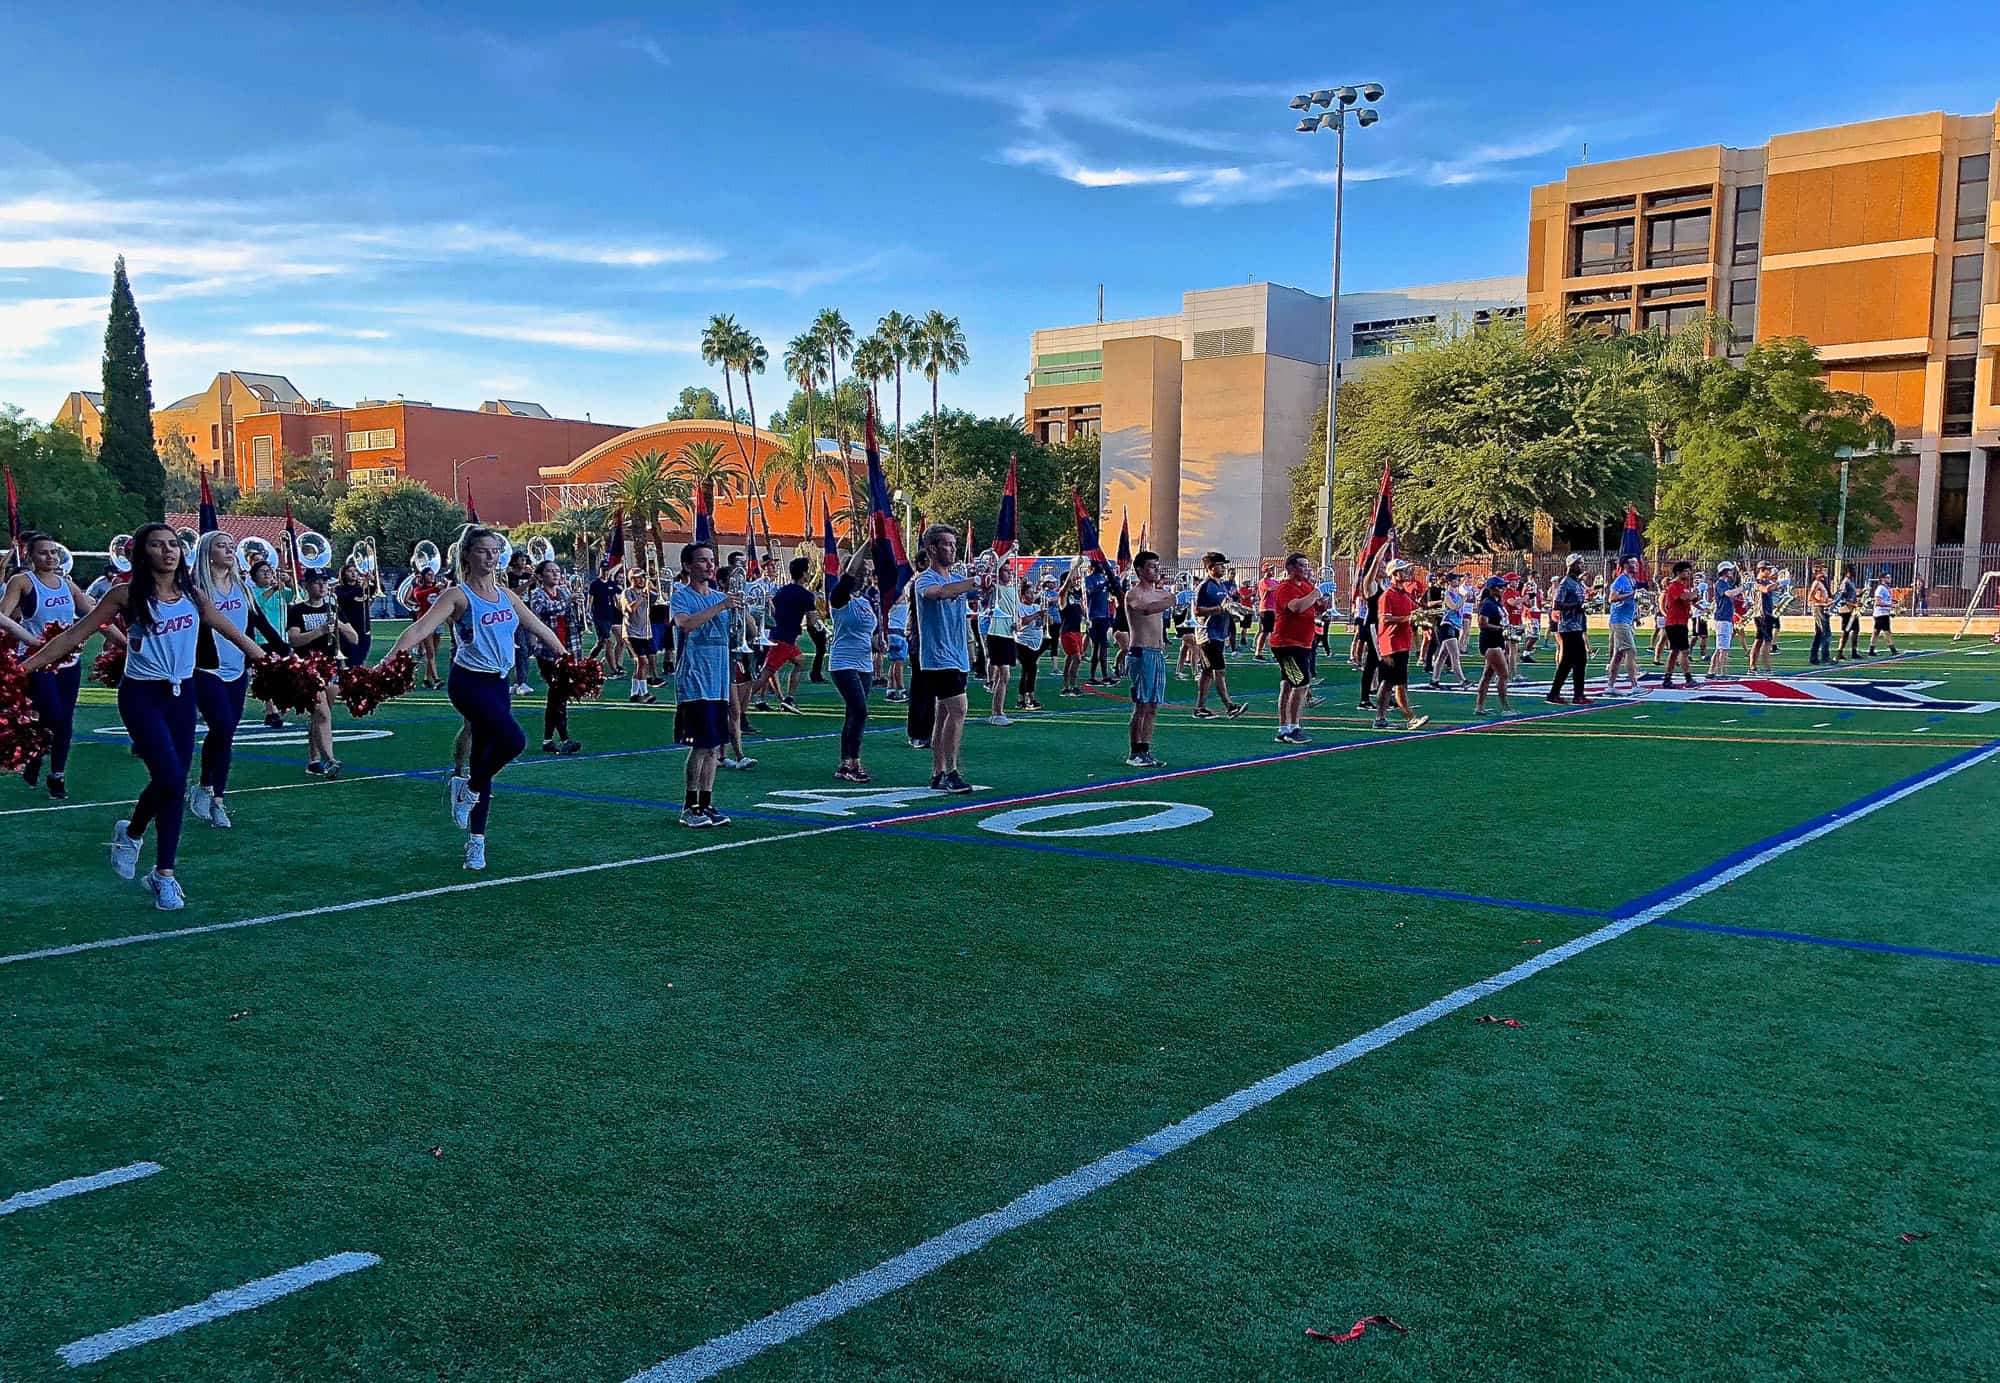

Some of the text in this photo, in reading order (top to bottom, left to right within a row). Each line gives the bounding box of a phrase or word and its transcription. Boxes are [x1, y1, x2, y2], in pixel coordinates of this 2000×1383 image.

[45, 596, 70, 608] CATS
[151, 613, 193, 636] CATS
[481, 608, 513, 626] CATS
